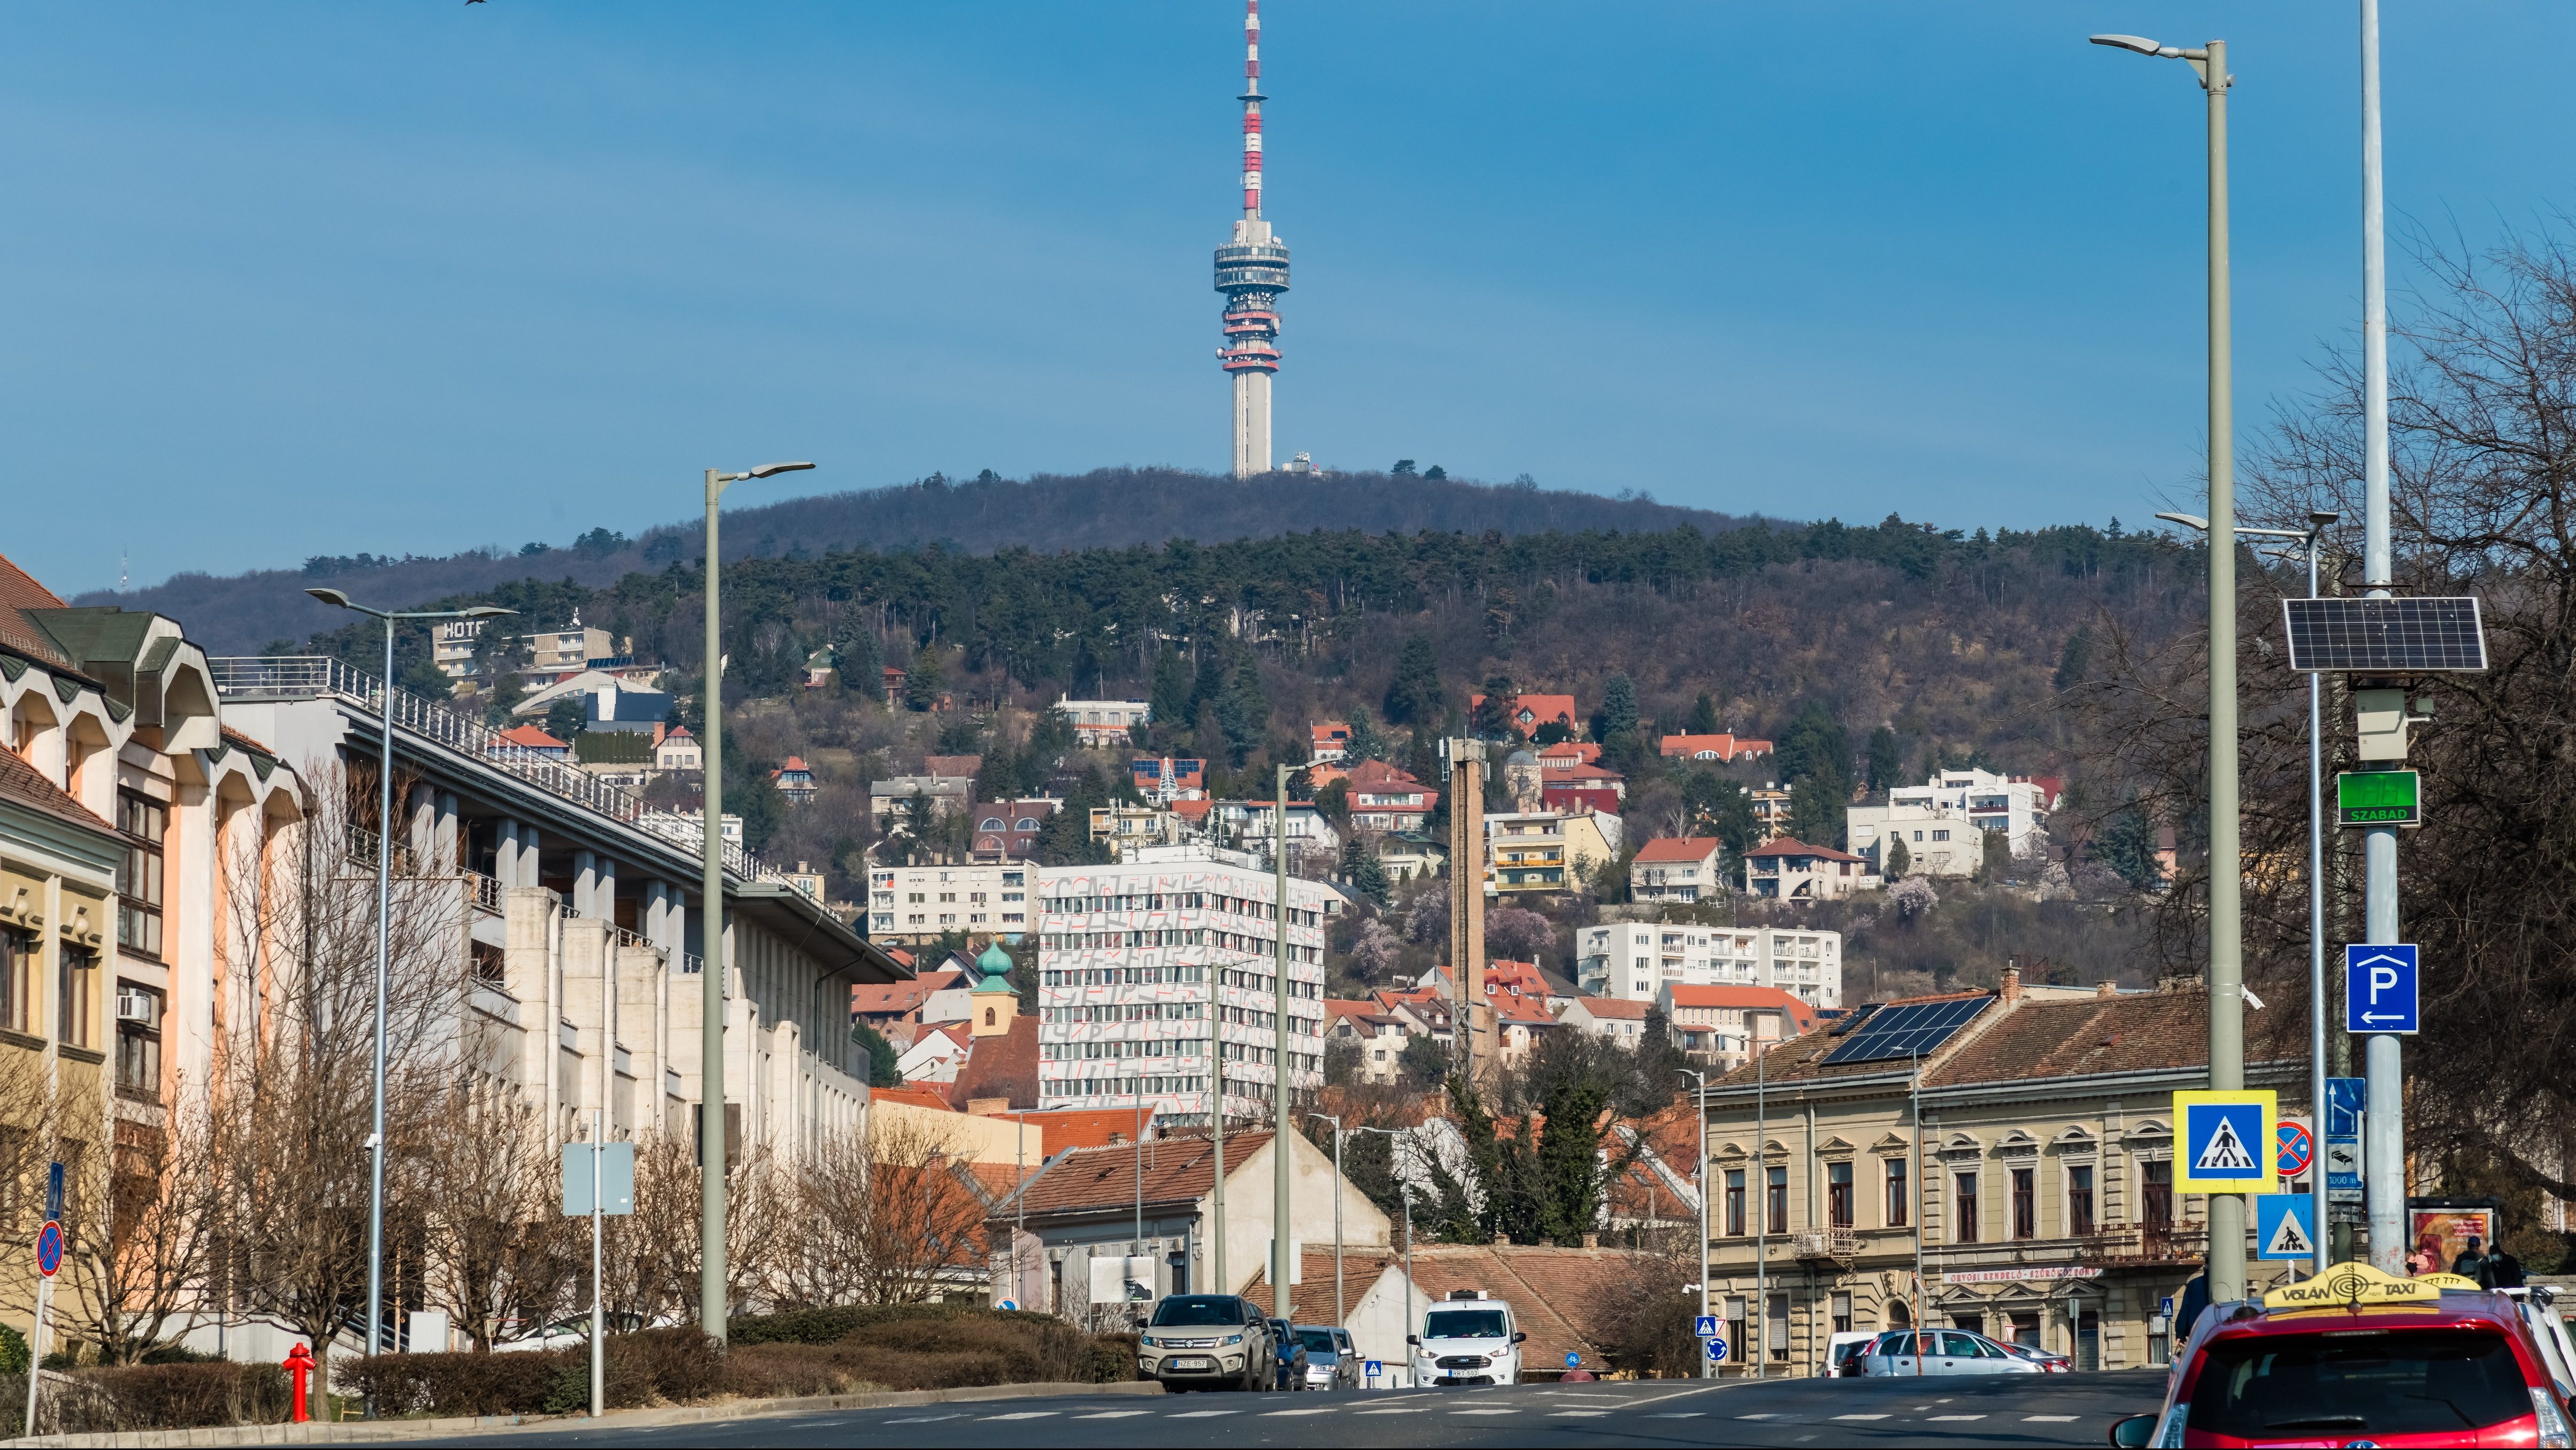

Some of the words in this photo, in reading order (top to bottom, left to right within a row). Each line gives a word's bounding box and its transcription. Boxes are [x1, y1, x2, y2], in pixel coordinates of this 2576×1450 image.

[444, 621, 489, 638] HOTE
[2351, 809, 2408, 821] SZABAD
[2370, 967, 2398, 1005] P
[2329, 1176, 2347, 1184] 1000
[2282, 1286, 2331, 1301] VOLÁN
[2384, 1283, 2416, 1295] TAXI
